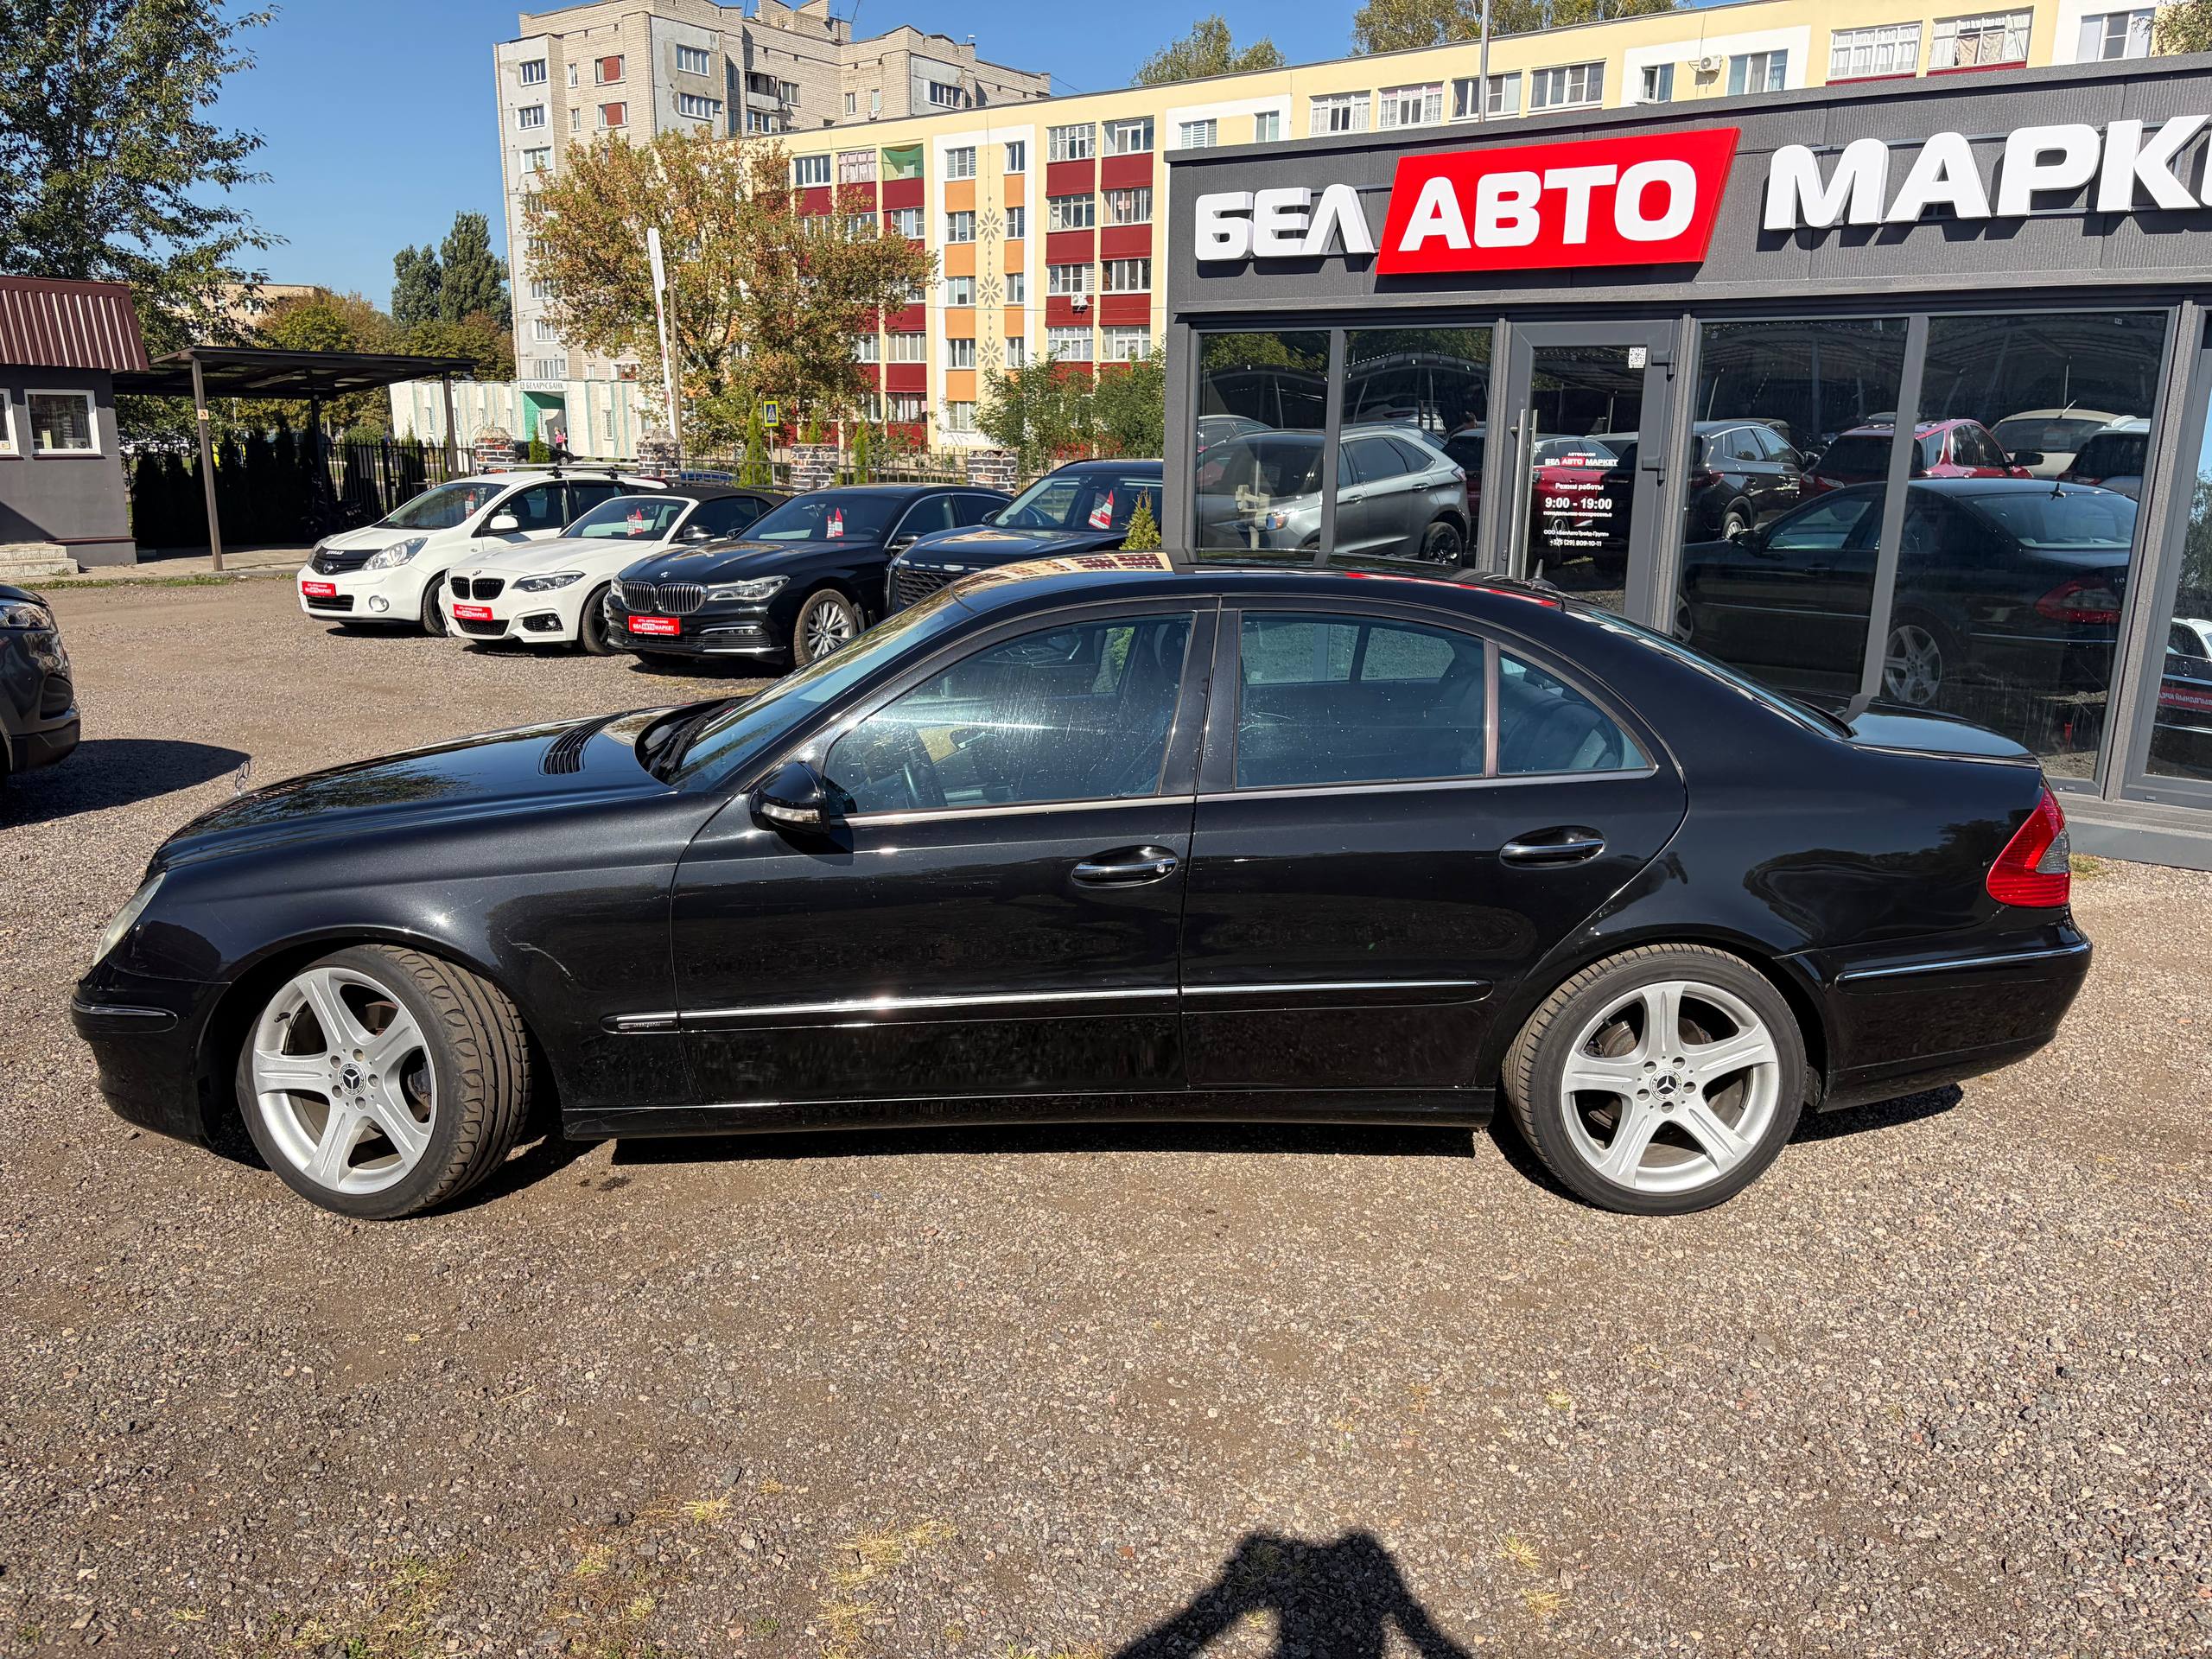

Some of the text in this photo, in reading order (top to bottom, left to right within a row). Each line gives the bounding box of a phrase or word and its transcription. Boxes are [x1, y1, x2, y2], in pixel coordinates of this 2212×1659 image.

[1194, 113, 2212, 260] БЕЛ АВТО МАРК
[1545, 497, 1570, 508] 9:00
[1580, 498, 1612, 510] 19:00
